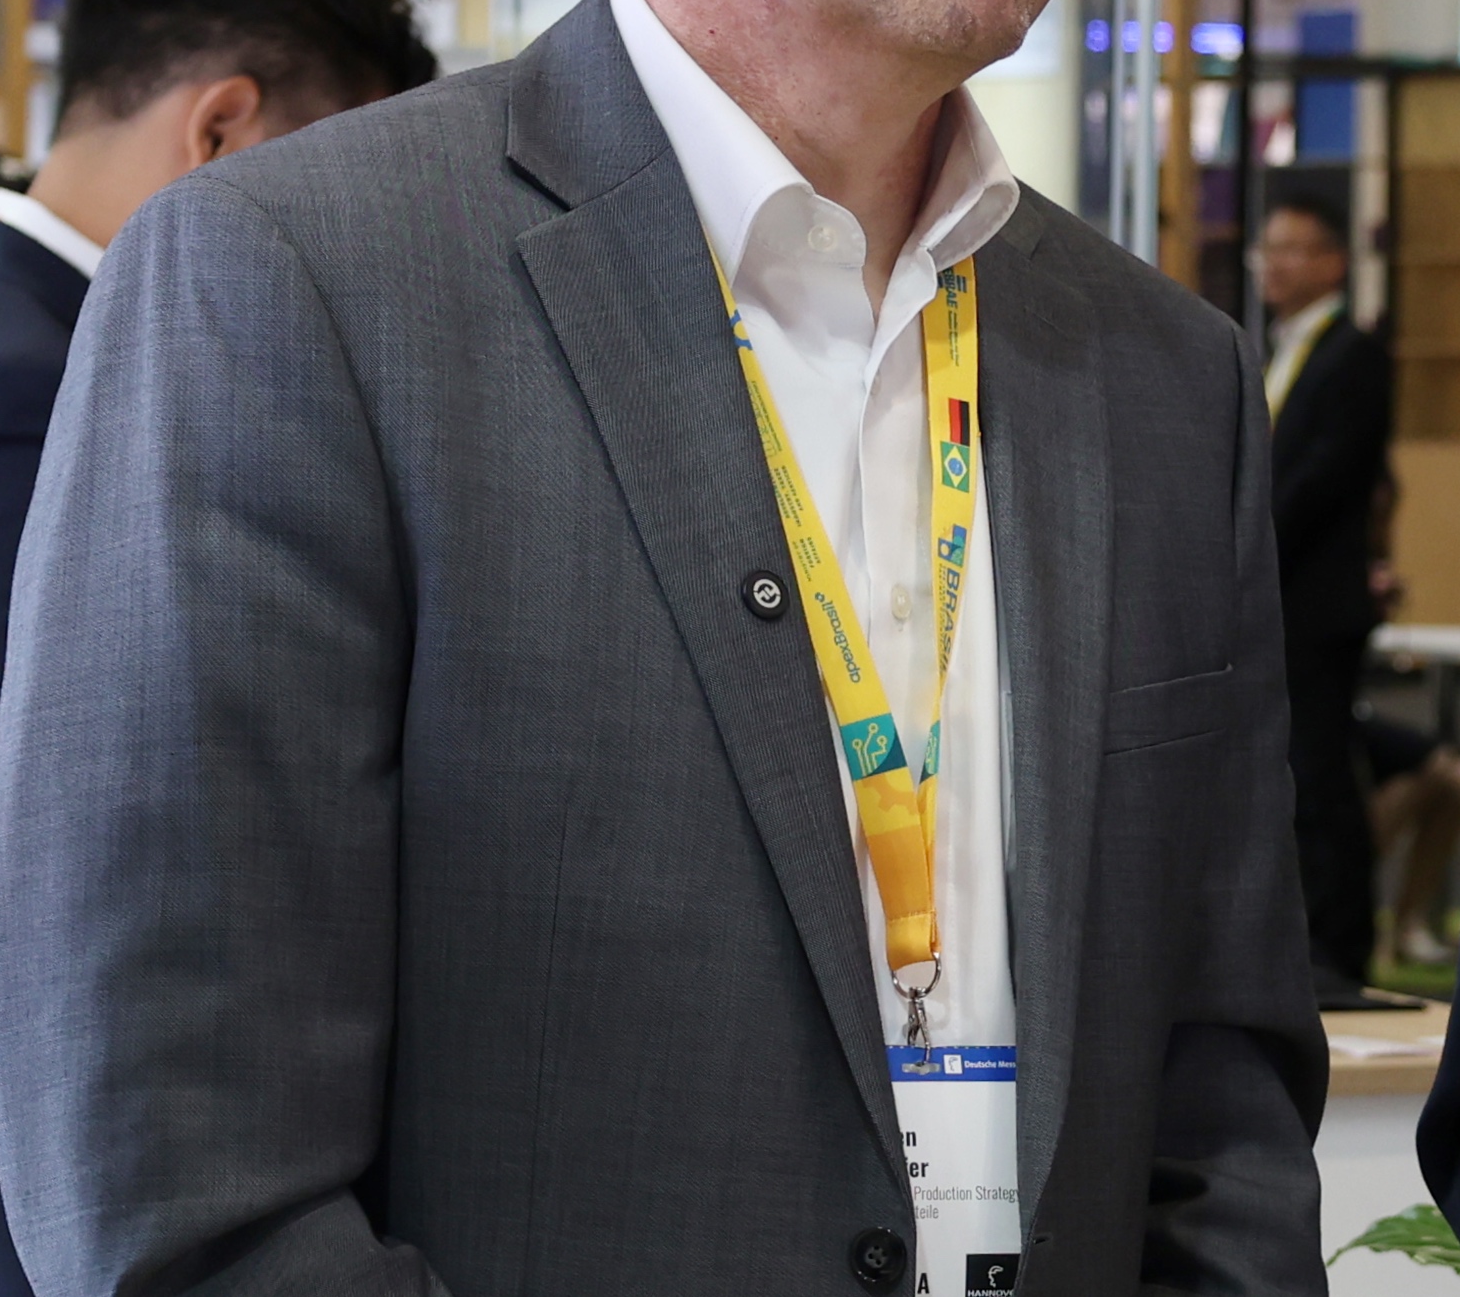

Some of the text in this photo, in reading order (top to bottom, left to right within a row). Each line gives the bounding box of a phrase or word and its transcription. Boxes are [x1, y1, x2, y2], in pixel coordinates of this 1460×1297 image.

[819, 594, 862, 684] apexBrasil
[964, 1060, 997, 1069] Deutsche
[913, 1186, 973, 1201] Production
